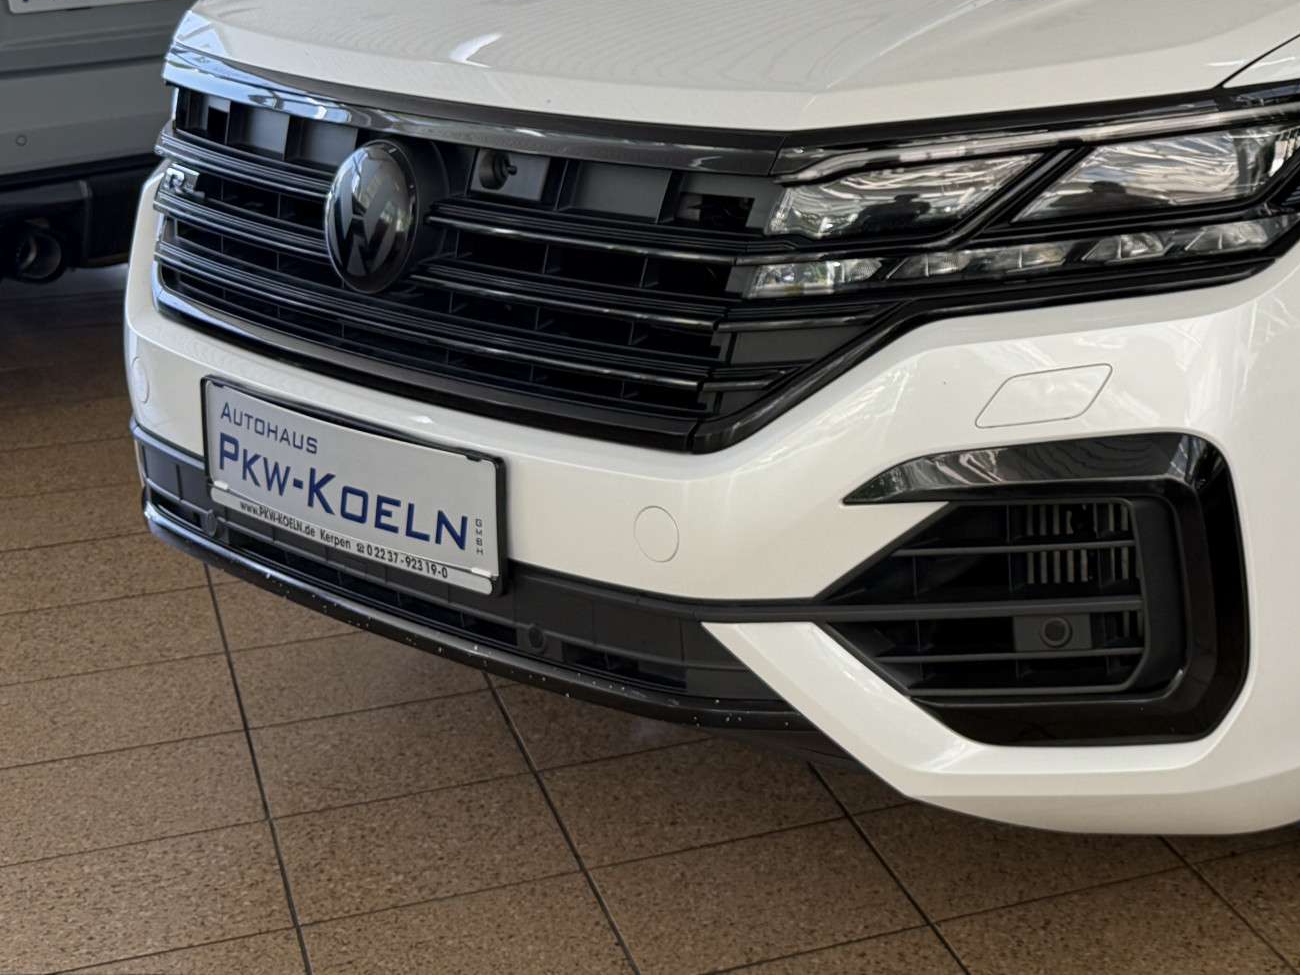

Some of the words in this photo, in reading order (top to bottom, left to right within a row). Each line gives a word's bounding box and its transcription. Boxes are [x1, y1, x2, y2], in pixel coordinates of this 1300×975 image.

[220, 402, 318, 455] AUTOHAUS
[218, 432, 469, 551] PKW-KOELN
[320, 528, 352, 550] Kerpen
